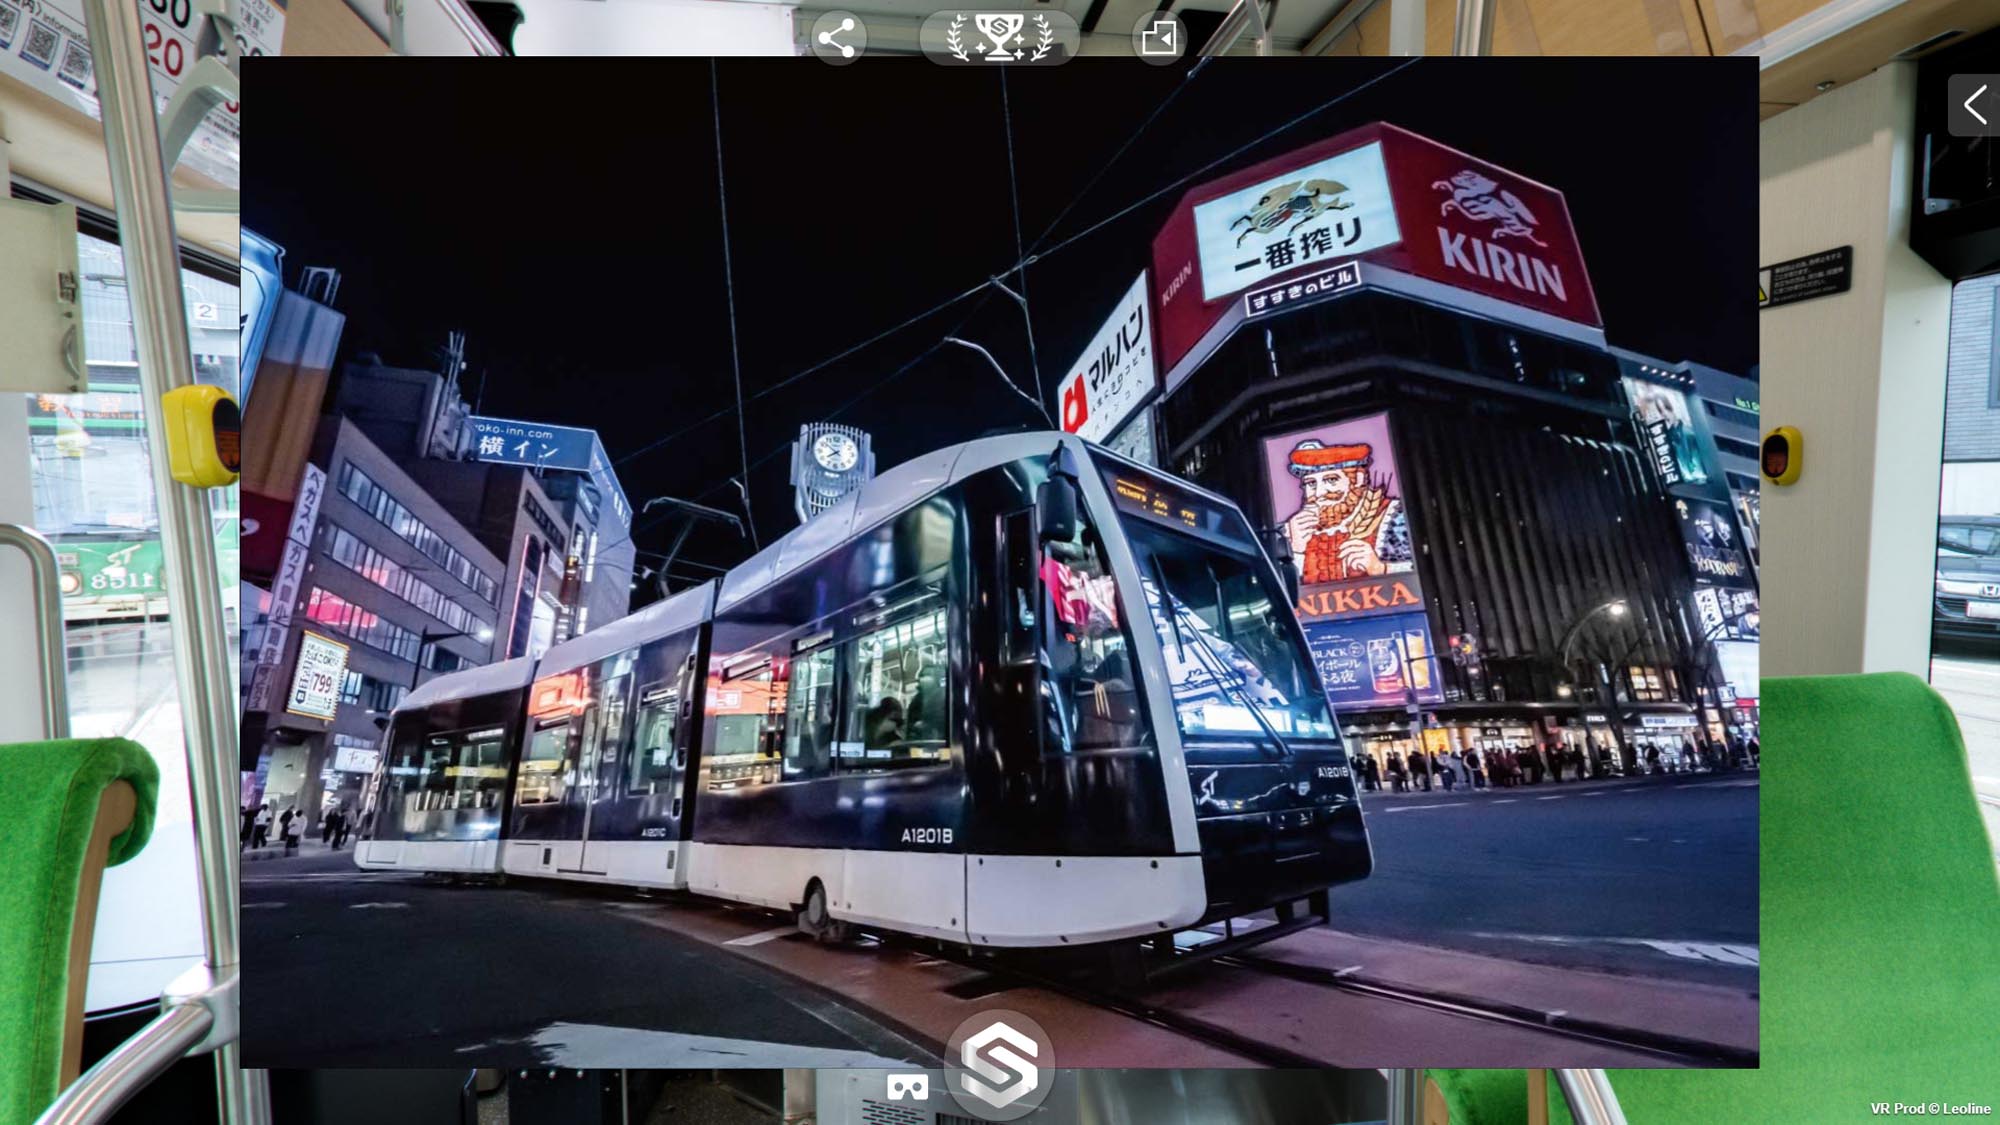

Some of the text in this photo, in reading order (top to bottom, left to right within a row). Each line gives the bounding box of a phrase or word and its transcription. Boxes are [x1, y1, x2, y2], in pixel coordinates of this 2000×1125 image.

[1234, 216, 1362, 272] 一番搾り
[1437, 226, 1568, 302] KIRIN
[1161, 262, 1193, 307] KIRIN
[1252, 269, 1353, 310] すすきのビル
[199, 304, 213, 318] 2
[1088, 303, 1145, 393] マルハン
[479, 435, 559, 458] 横イン
[1294, 581, 1420, 618] NIKKA
[901, 827, 954, 844] A1201B
